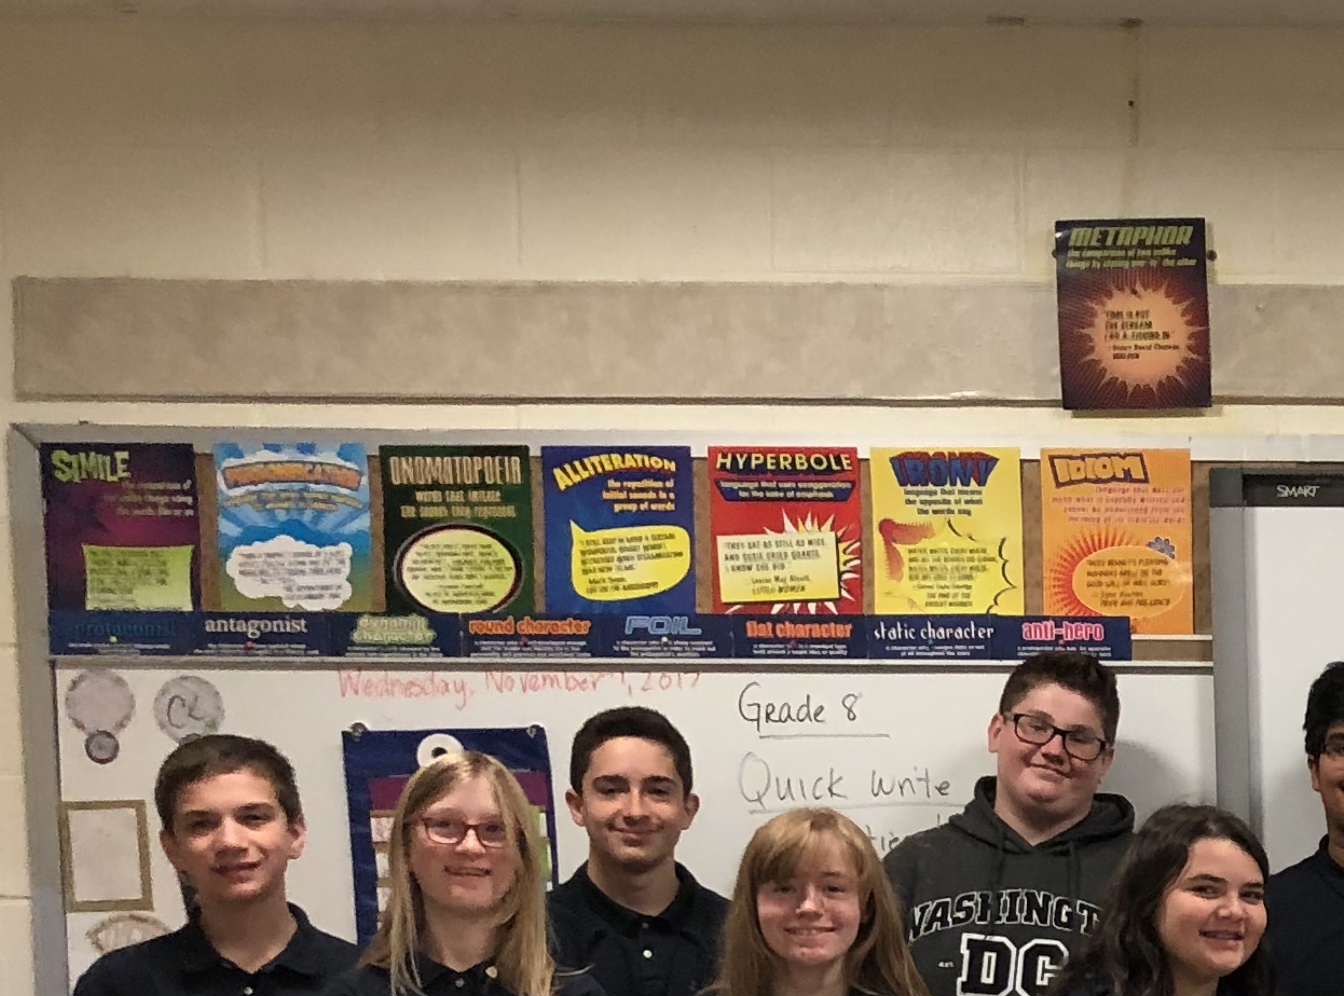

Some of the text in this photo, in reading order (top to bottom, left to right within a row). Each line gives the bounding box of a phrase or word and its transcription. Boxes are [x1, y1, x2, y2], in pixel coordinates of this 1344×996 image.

[1068, 226, 1194, 246] METAPHOR
[51, 449, 133, 483] SIMILE
[390, 456, 522, 485] ONOMATOPOEIA
[552, 453, 677, 492] ALLITERATION
[716, 453, 853, 471] HYPERBOLE
[889, 451, 1000, 488] IRONY
[1051, 454, 1147, 486] IDIOM
[1276, 484, 1319, 498] SMART
[205, 614, 308, 639] antagonist
[469, 615, 591, 635] round character
[625, 616, 702, 635] FOIL
[746, 621, 852, 639] flat character
[874, 621, 994, 641] static character
[1022, 620, 1105, 641] anti-hero
[485, 670, 599, 692] November
[641, 671, 702, 693] 2017
[738, 681, 862, 733] Grade 8
[738, 751, 848, 811] Quick
